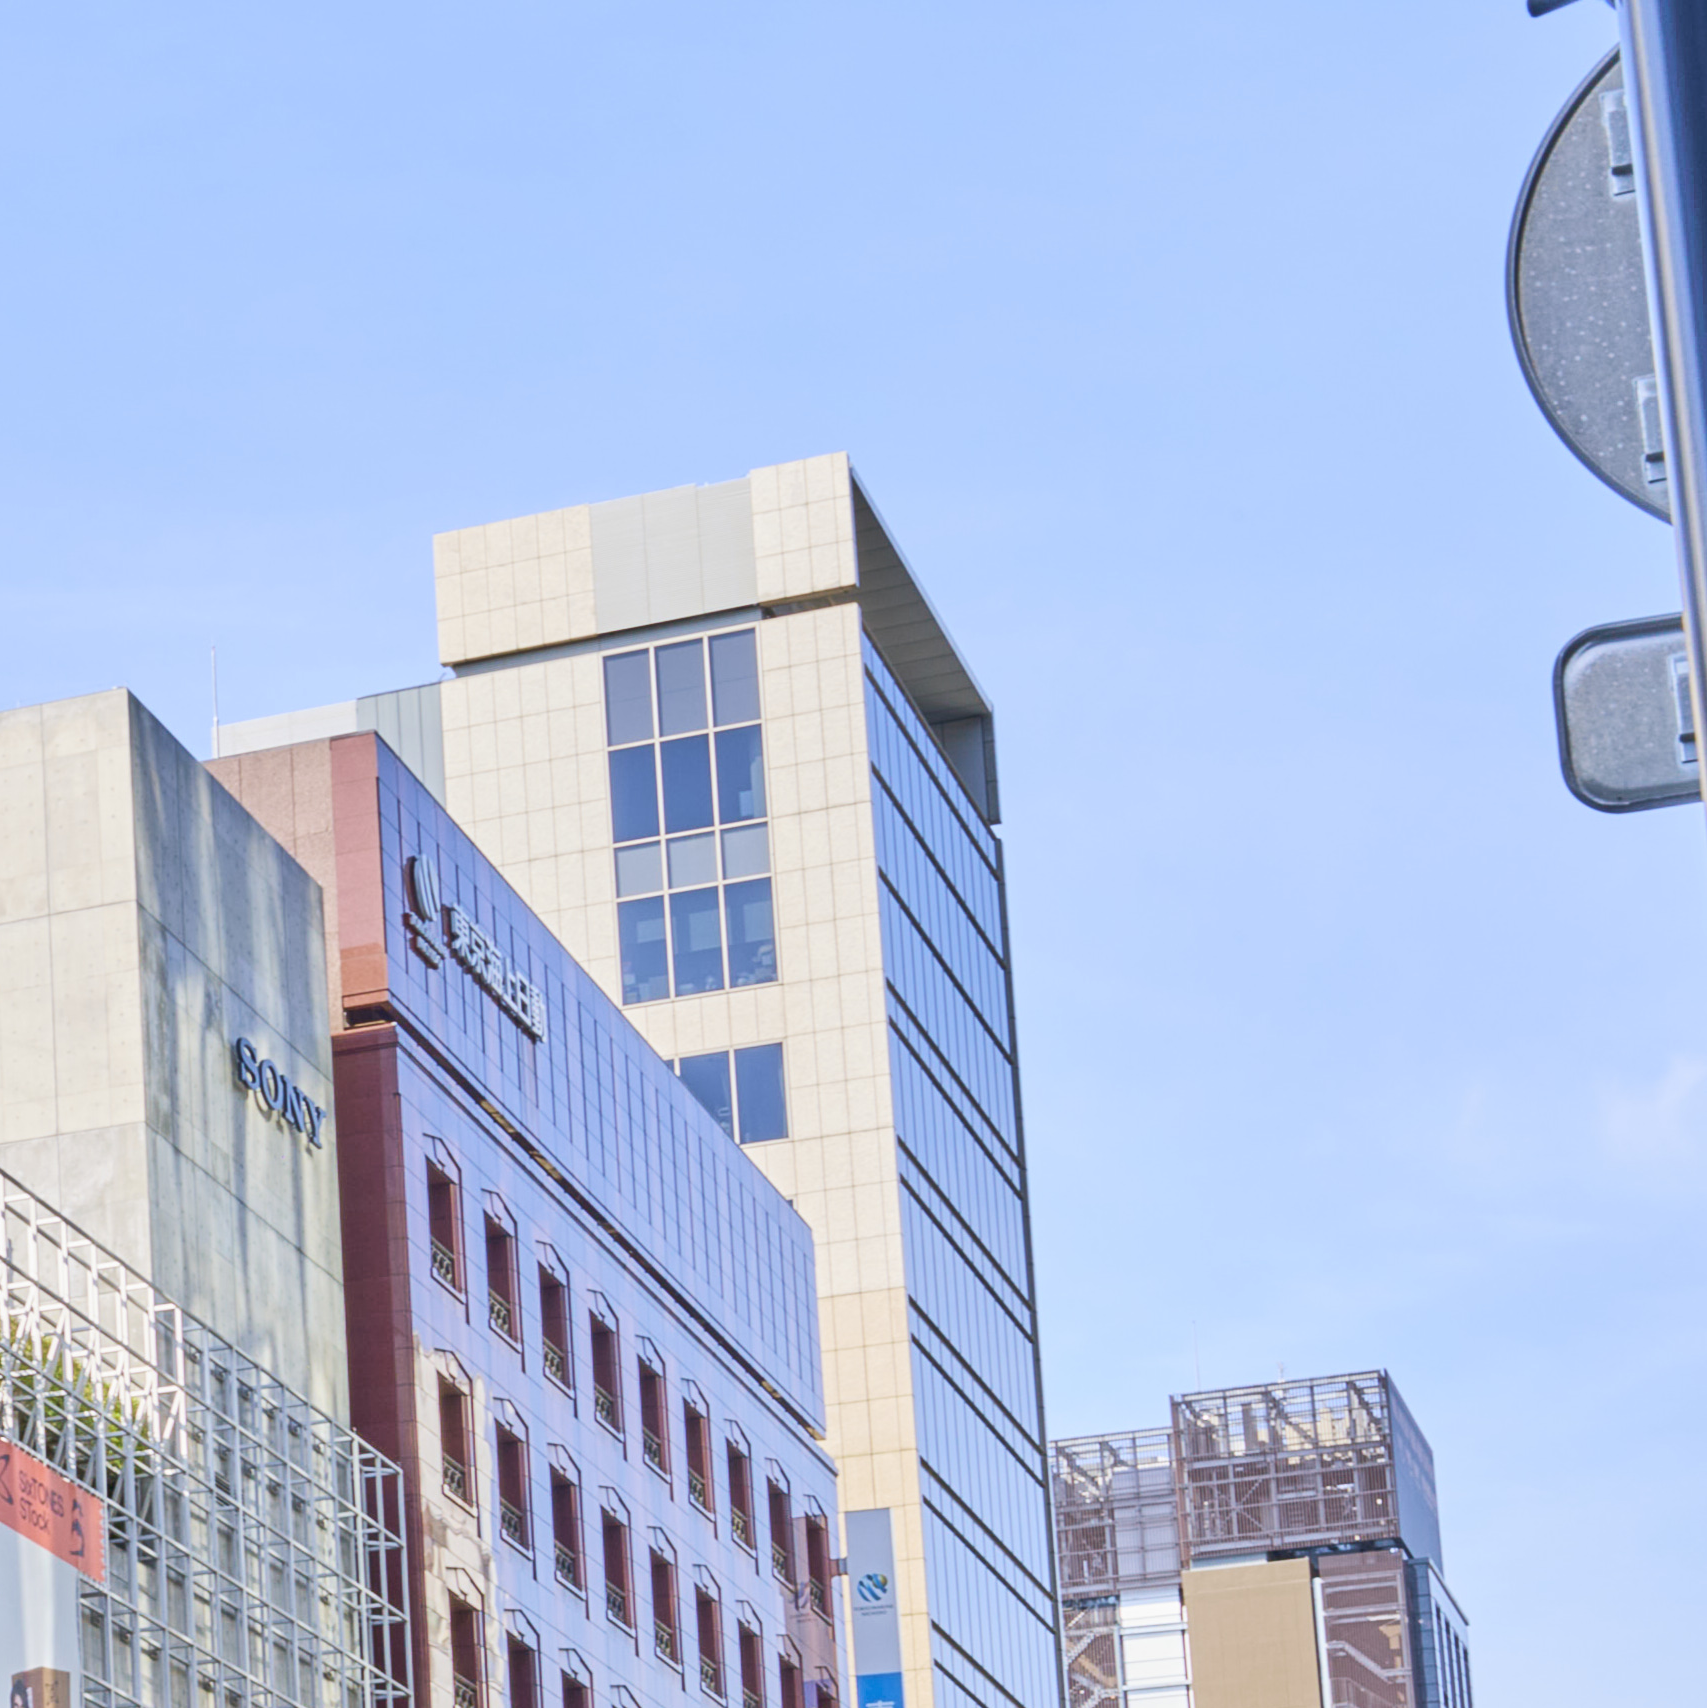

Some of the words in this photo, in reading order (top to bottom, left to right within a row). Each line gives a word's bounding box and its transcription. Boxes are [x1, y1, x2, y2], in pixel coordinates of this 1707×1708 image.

[447, 902, 547, 1043] 東京海上日動
[236, 1036, 327, 1150] SONY
[18, 1469, 65, 1519] SixTONES
[19, 1497, 51, 1535] STock
